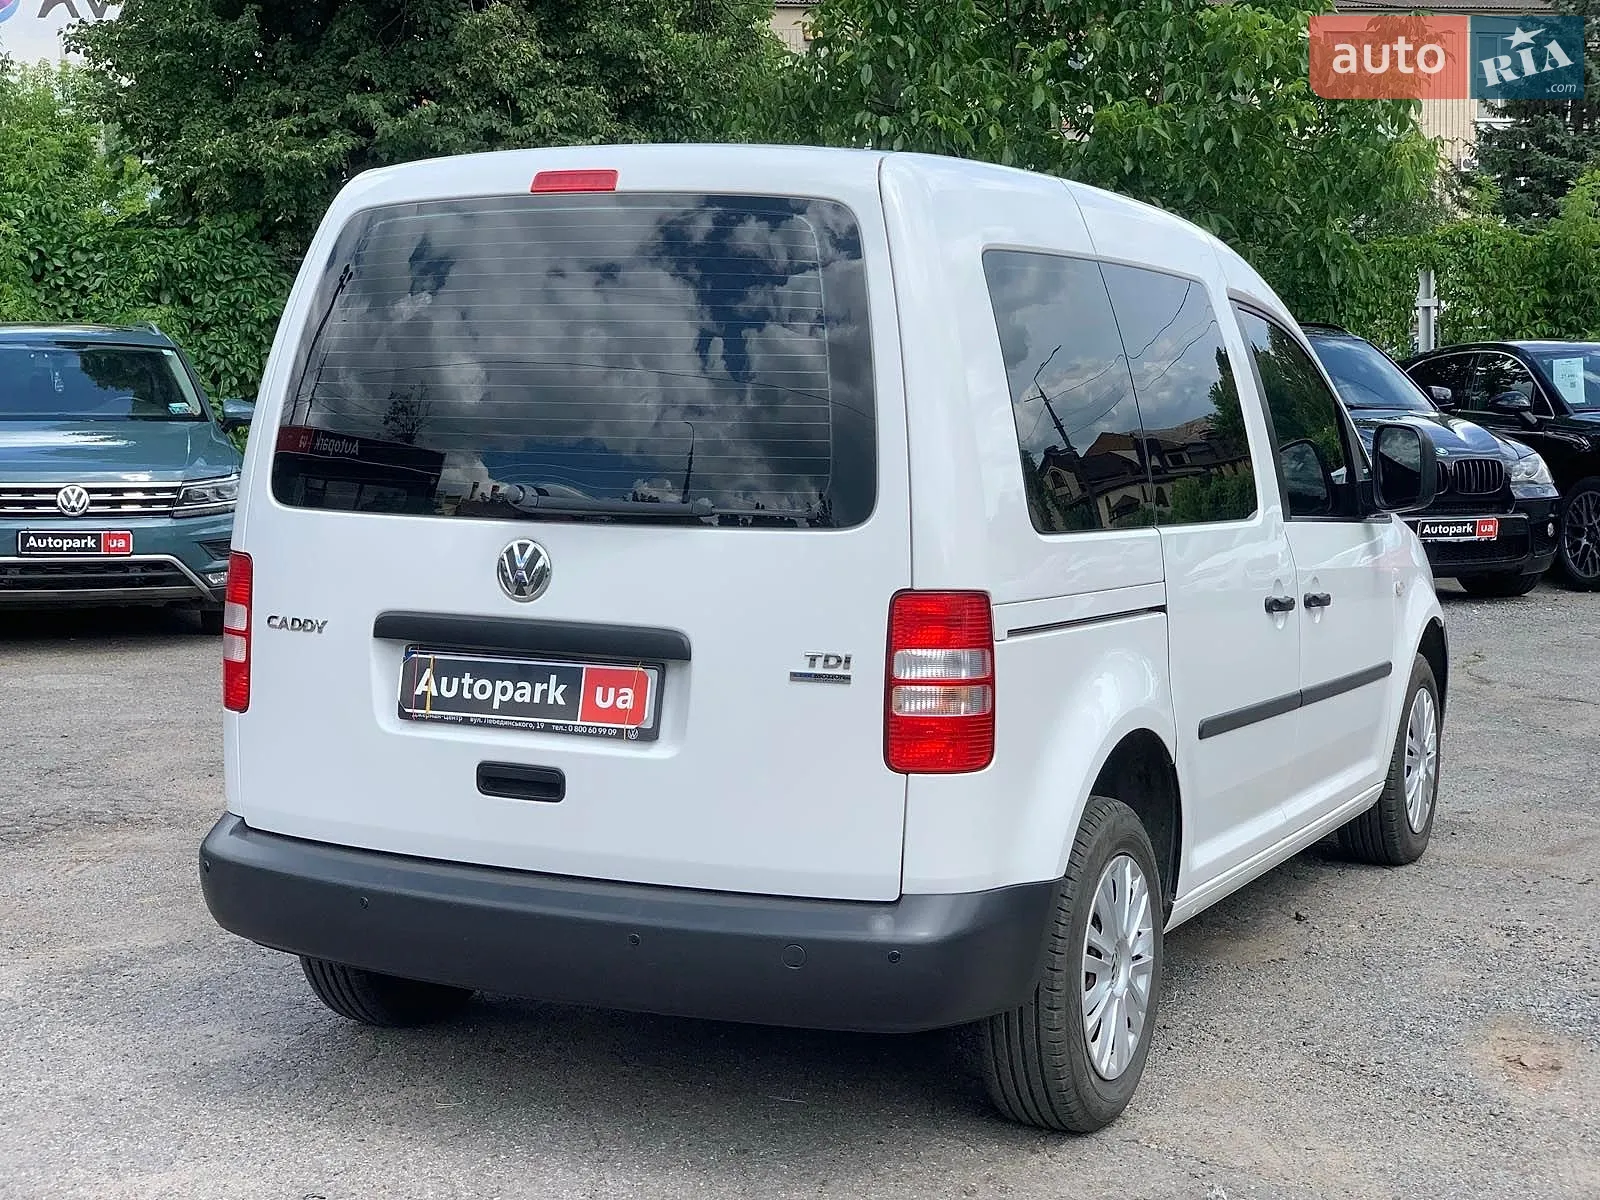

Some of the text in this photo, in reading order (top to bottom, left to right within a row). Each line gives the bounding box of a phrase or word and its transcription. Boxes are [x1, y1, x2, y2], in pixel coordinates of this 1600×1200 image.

[1422, 523, 1494, 536] Autopark ua
[26, 535, 126, 551] Autopark ua
[266, 615, 328, 634] CADDY
[804, 652, 852, 670] TDI
[414, 667, 635, 710] Autopark ua
[574, 725, 587, 733] 800
[588, 726, 597, 734] 60
[598, 727, 607, 735] 99
[608, 728, 617, 736] 09
